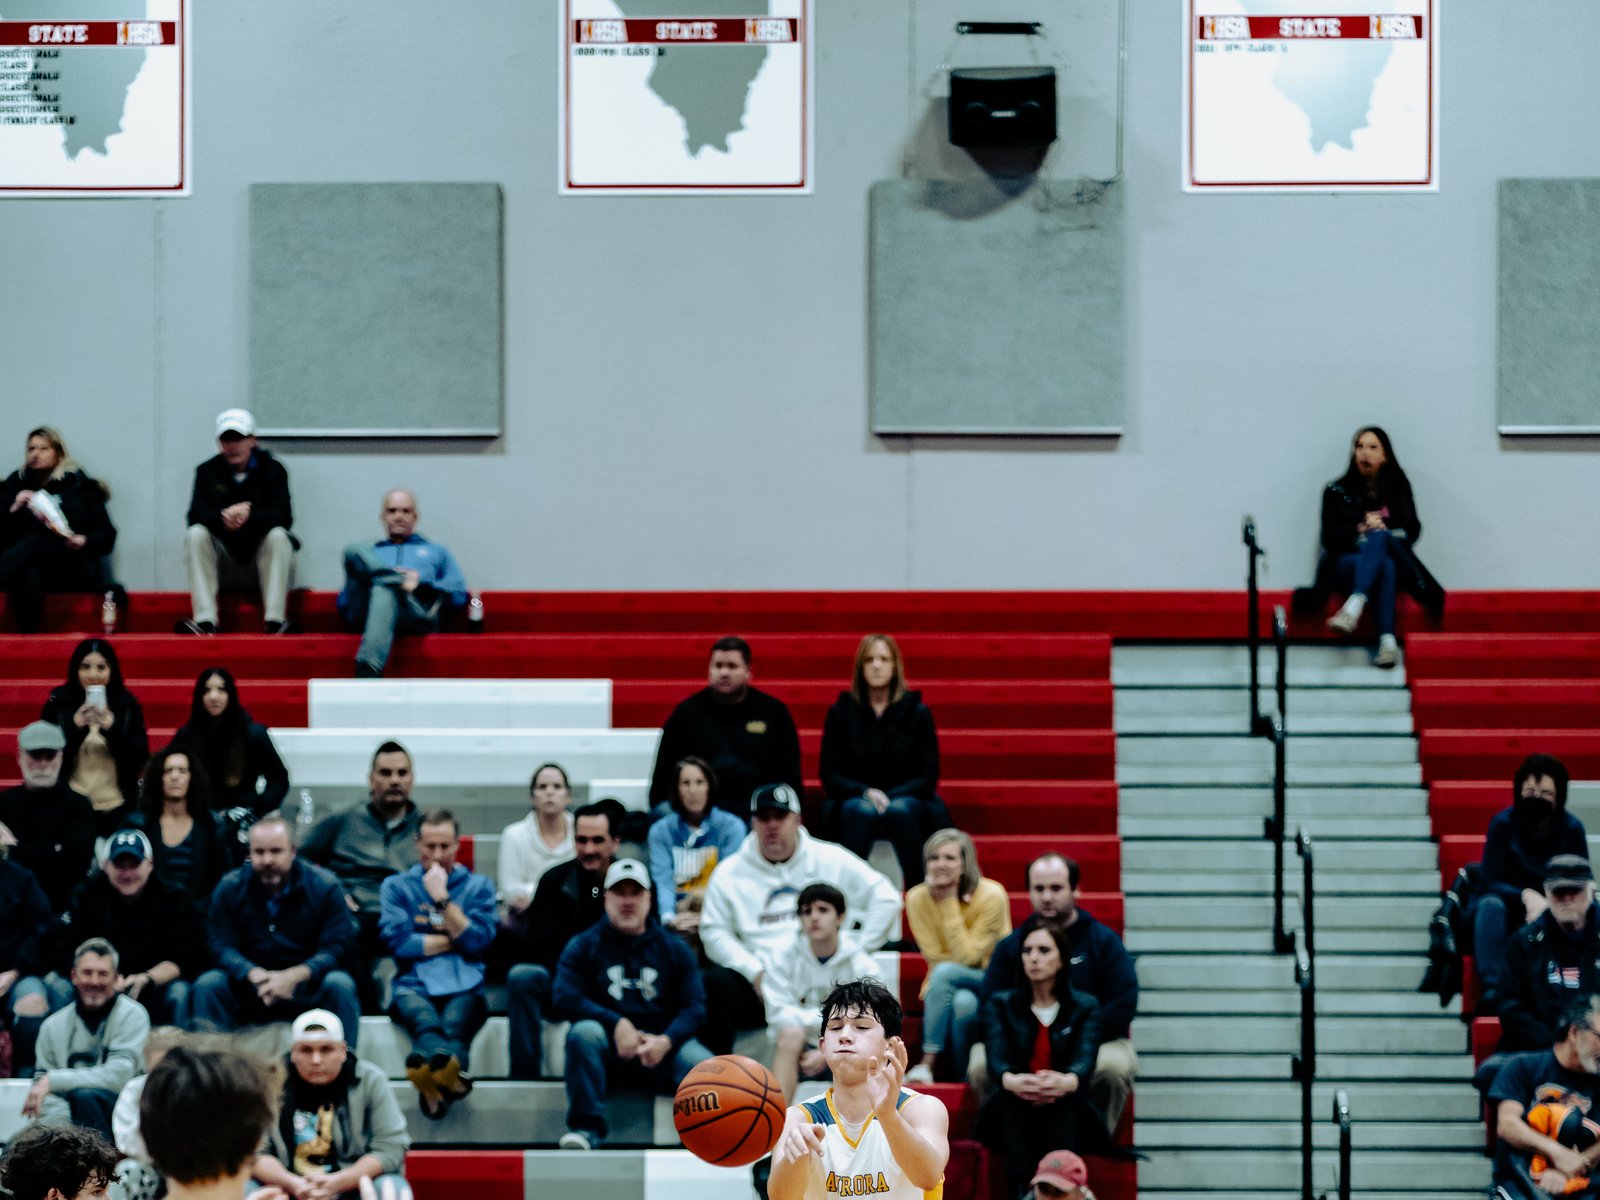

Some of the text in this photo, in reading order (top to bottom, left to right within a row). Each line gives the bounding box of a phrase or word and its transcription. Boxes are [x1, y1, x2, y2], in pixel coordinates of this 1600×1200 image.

[28, 24, 88, 43] STATE
[655, 22, 718, 40] STATE
[1279, 18, 1341, 37] STATE
